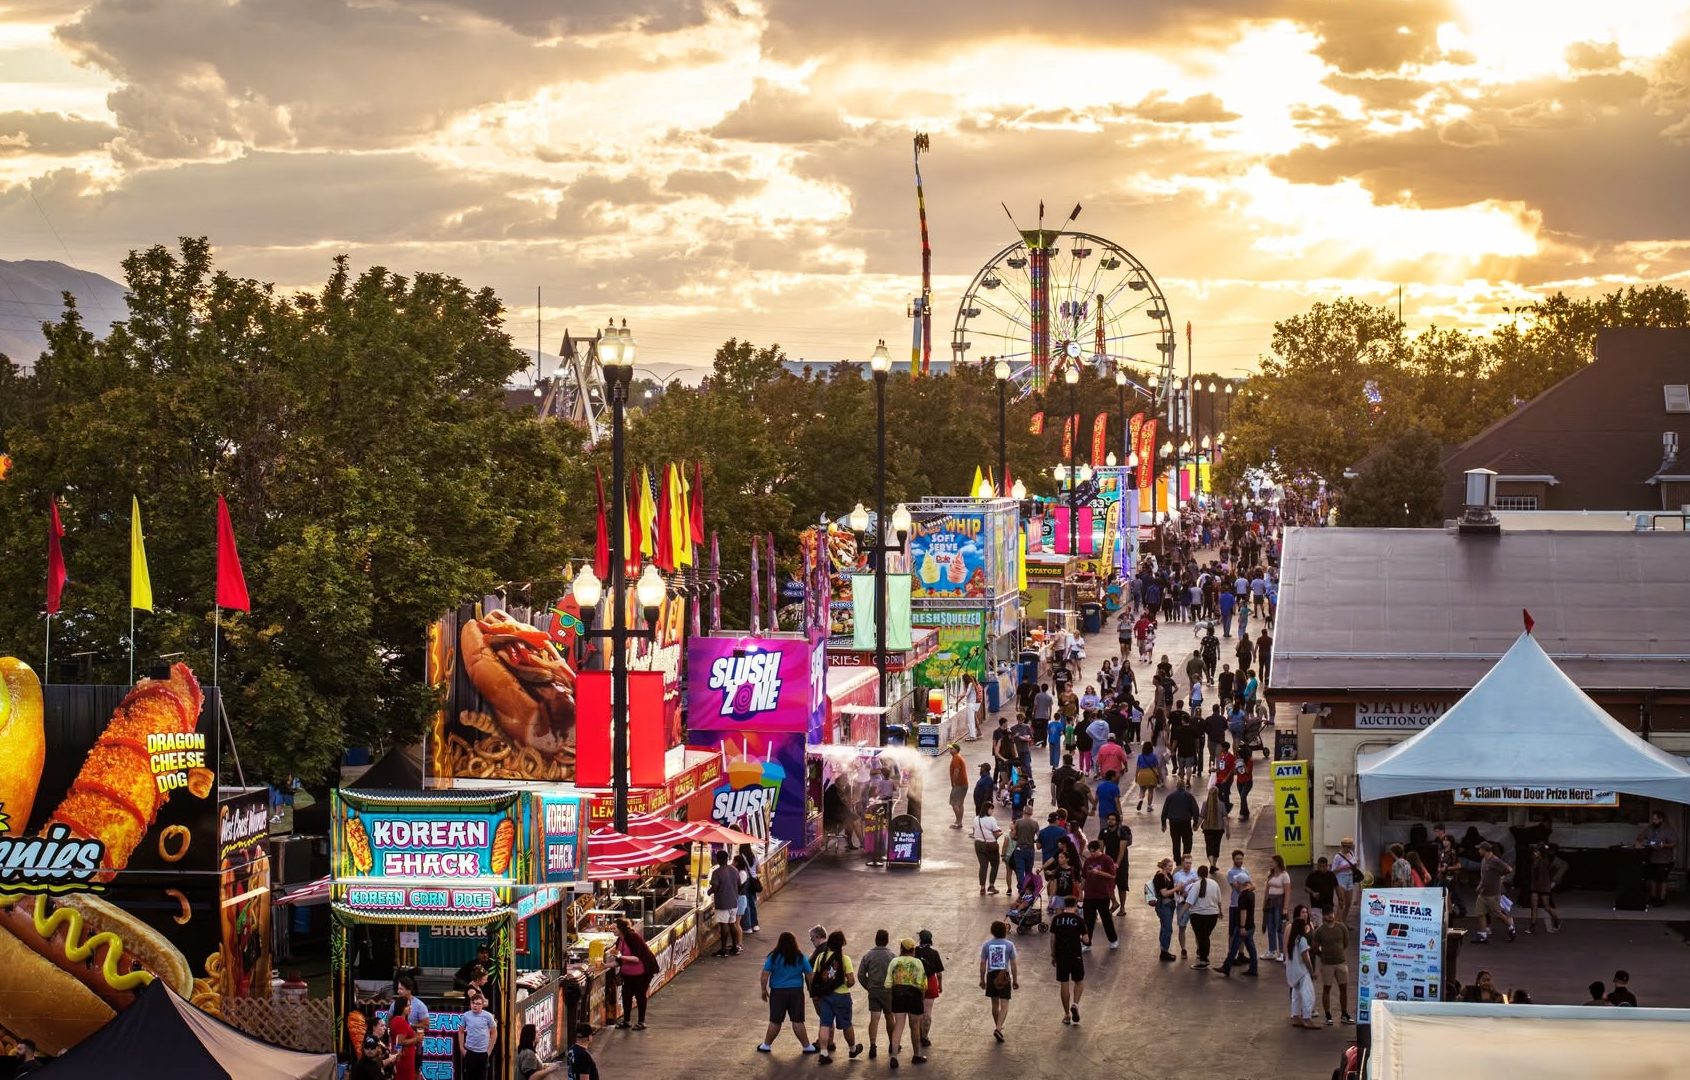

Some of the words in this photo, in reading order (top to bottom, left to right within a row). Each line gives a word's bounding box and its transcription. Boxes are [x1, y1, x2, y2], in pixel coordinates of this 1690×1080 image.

[931, 534, 955, 542] SOFT
[945, 518, 981, 541] WHIP
[929, 543, 957, 551] SERVE
[911, 613, 939, 624] RESH
[939, 612, 980, 625] SQUEEZED
[709, 652, 780, 688] SLUSH
[719, 680, 780, 716] ZONE
[1360, 716, 1415, 726] AUCTION
[1419, 716, 1438, 725] CO
[147, 733, 206, 754] DRAGON
[150, 751, 206, 774] CHEESE
[1276, 766, 1302, 776] ATM
[156, 772, 188, 794] DOG
[1475, 786, 1501, 799] Claim
[1502, 787, 1522, 799] Your
[1523, 788, 1545, 799] Door
[1546, 788, 1568, 800] Prize
[1569, 788, 1594, 800] Here!
[592, 803, 646, 818] LEMNADE
[713, 788, 775, 820] SLUSH
[546, 804, 576, 833] KOREAN
[1284, 793, 1302, 842] ATM
[373, 820, 488, 847] KOREAN
[384, 852, 480, 876] SHACK
[548, 844, 574, 870] SHACK
[350, 890, 404, 905] KOREAN
[410, 891, 447, 906] CORN
[454, 892, 492, 908] DOGS
[1390, 904, 1408, 914] THE
[430, 926, 488, 937] SHACK
[423, 1038, 452, 1054] RN
